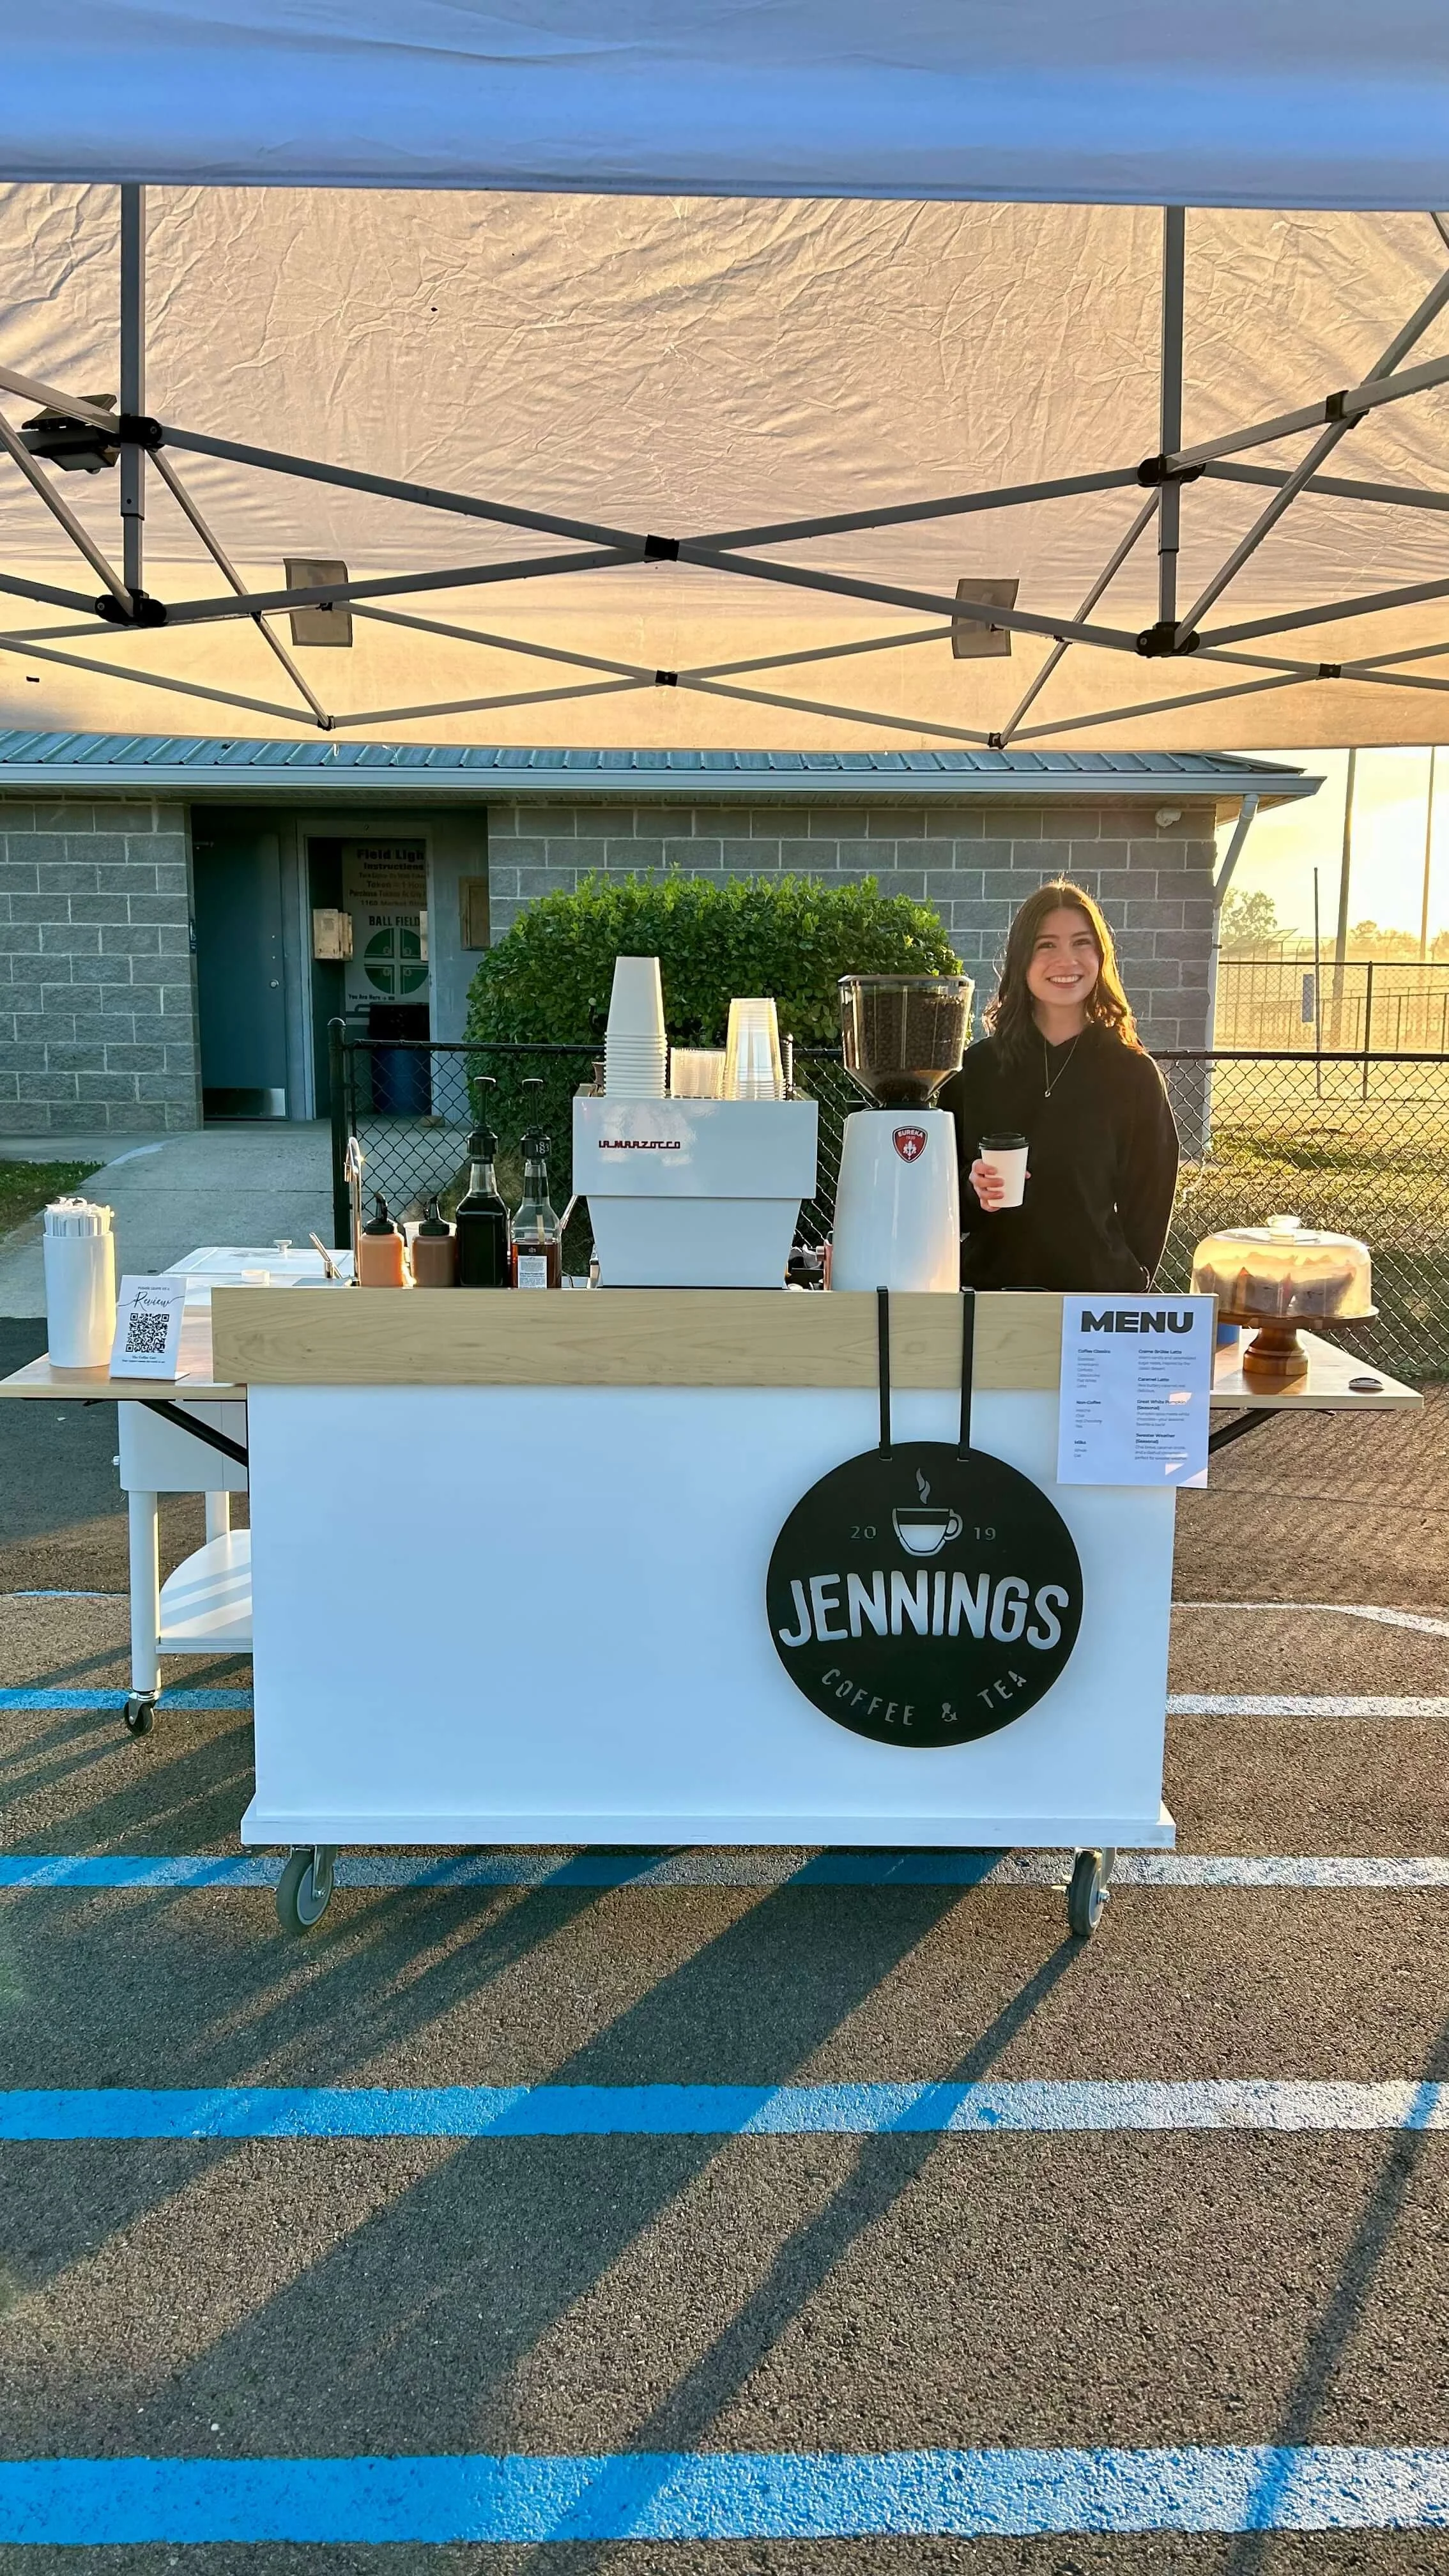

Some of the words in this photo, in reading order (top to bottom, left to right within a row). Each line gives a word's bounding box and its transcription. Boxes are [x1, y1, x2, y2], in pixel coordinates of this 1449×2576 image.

[357, 848, 390, 859] Field
[369, 916, 392, 926] BALL
[898, 1130, 923, 1138] EUREKA
[118, 1291, 184, 1311] Review
[1081, 1311, 1193, 1333] MENU
[849, 1526, 877, 1540] 20
[974, 1527, 996, 1541] 19
[778, 1570, 1070, 1650] JENNINGS
[821, 1668, 915, 1726] COFFEE
[940, 1702, 958, 1722] &
[977, 1670, 1027, 1708] TEA
